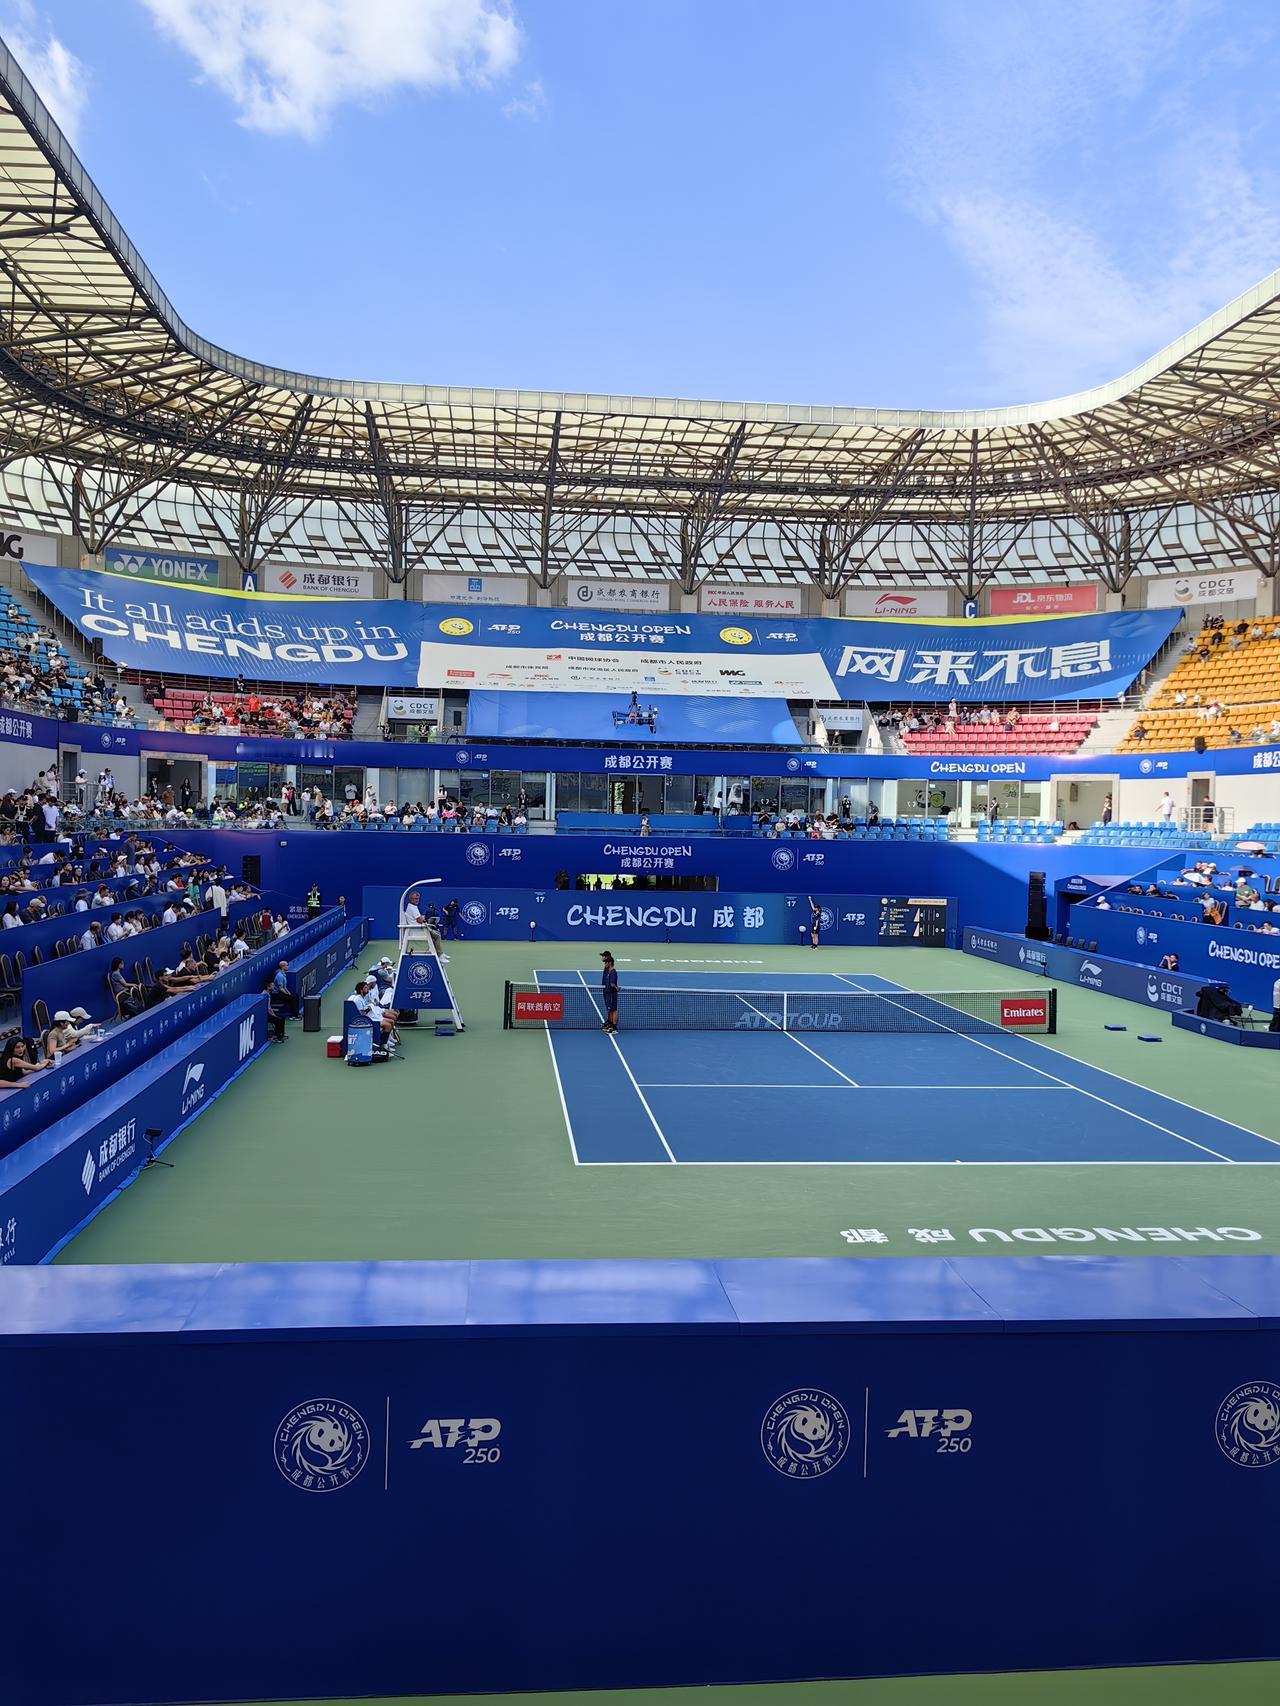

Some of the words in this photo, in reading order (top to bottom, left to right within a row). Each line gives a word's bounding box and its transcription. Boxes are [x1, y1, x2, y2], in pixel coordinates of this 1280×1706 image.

[151, 557, 209, 581] YONEX
[244, 575, 256, 592] A
[303, 573, 360, 588] 成都银行
[1198, 578, 1235, 589] CDCT
[708, 598, 749, 608] 人民保险
[753, 600, 795, 609] 服务人民
[1012, 592, 1036, 604] JDL
[79, 587, 116, 613] It
[125, 602, 178, 627] all
[185, 612, 286, 640] adds
[294, 626, 348, 646] up
[355, 621, 401, 640] in
[965, 602, 976, 619] C
[550, 620, 638, 633] CHENGDU
[641, 625, 692, 635] OPEN
[80, 613, 409, 663] CHENGDU
[580, 633, 665, 644] 成都公开赛
[835, 639, 1113, 686] 网来不息
[409, 702, 434, 710] CDCT
[604, 755, 673, 770] 成都公开赛
[930, 761, 989, 774] CHENGDU
[992, 762, 1025, 774] OPEN
[498, 848, 521, 857] ATP
[603, 843, 659, 856] CHENGDU
[660, 845, 692, 857] OPEN
[803, 853, 825, 861] ATP
[620, 857, 675, 869] 成都公开赛
[495, 907, 519, 915] ATP
[567, 904, 697, 928] CHENGDU
[712, 906, 765, 929] 成都
[843, 913, 865, 921] ATP
[1208, 940, 1258, 966] CHENGDU
[1079, 974, 1103, 988] LI-NING
[1161, 982, 1183, 995] CDCT
[409, 991, 432, 999] ATP
[517, 1002, 561, 1012] 阿联酋航空
[1003, 1006, 1044, 1018] Emirates
[734, 1012, 783, 1029] ATP
[785, 1013, 843, 1028] TOUR
[182, 1083, 205, 1115] LI-NING
[98, 1117, 137, 1168] 成都银行
[116, 1144, 136, 1167] CHENGDU
[967, 1227, 1263, 1243] CHENGDU
[766, 1393, 819, 1430] CHENGDU
[820, 1398, 846, 1430] OPEN
[1220, 1385, 1270, 1422] CHENGDU
[279, 1403, 336, 1443] CHENGDU
[338, 1407, 365, 1441] OPEN
[883, 1408, 973, 1438] ATP
[406, 1418, 502, 1449] ATP
[936, 1437, 972, 1453] 250
[462, 1447, 501, 1464] 250
[776, 1456, 834, 1476] 成都公开赛
[290, 1468, 353, 1490] 成都公开赛
